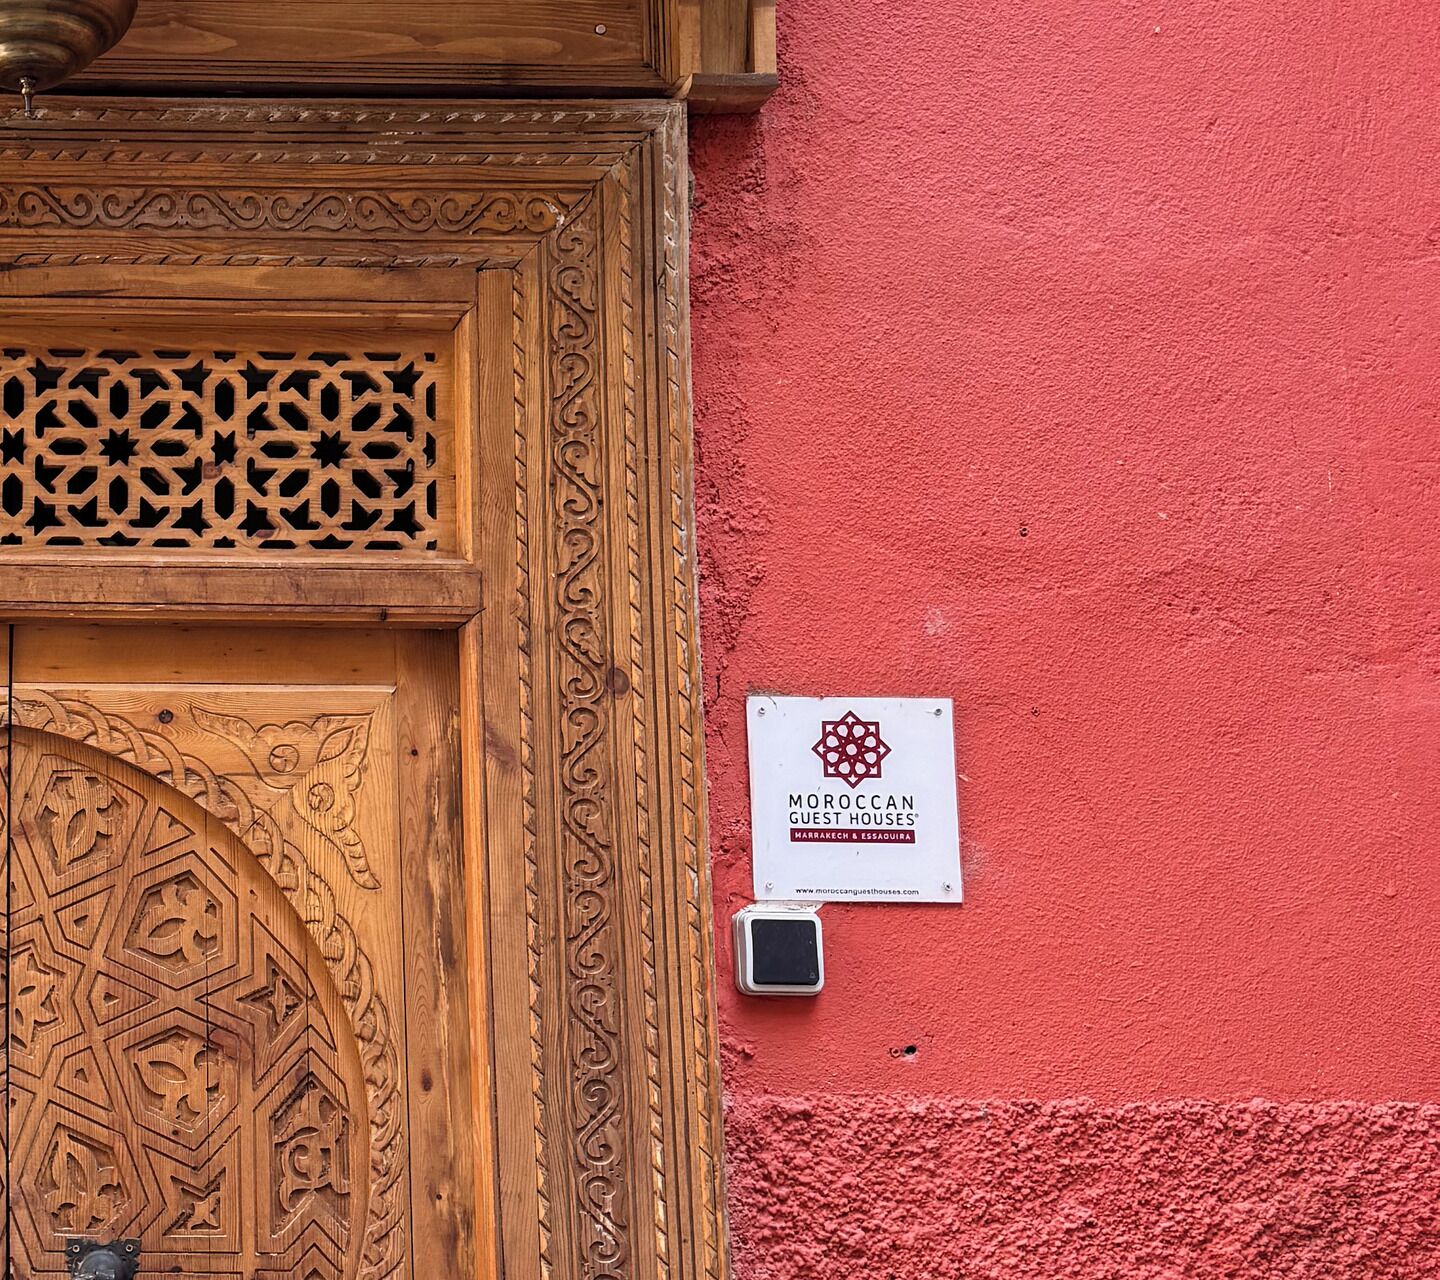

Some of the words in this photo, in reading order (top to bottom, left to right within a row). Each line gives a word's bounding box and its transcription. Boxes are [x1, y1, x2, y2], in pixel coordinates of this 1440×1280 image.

[789, 793, 914, 810] MOROCCAN
[789, 811, 842, 825] GUEST
[794, 831, 849, 840] MARRAKECH
[852, 832, 858, 840] &
[795, 888, 920, 897] www.moroccanguesthouses.com
